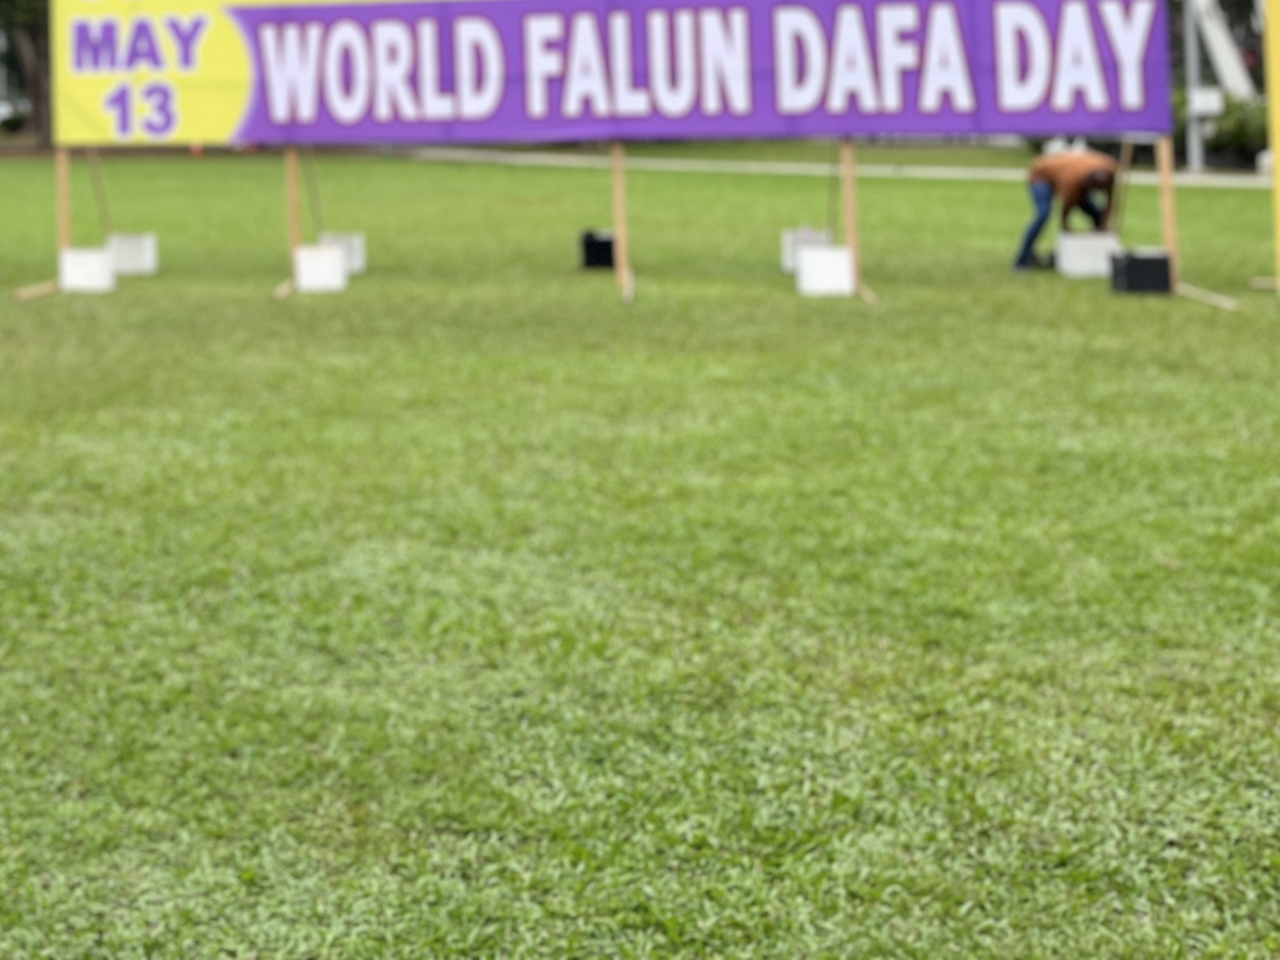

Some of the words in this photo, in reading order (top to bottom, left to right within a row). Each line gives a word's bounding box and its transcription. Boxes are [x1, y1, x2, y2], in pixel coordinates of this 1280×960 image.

[72, 16, 207, 72] MAY
[259, 14, 504, 124] WORLD
[524, 5, 753, 120] FALUN
[772, 0, 977, 116] DAFA
[105, 81, 178, 137] 13
